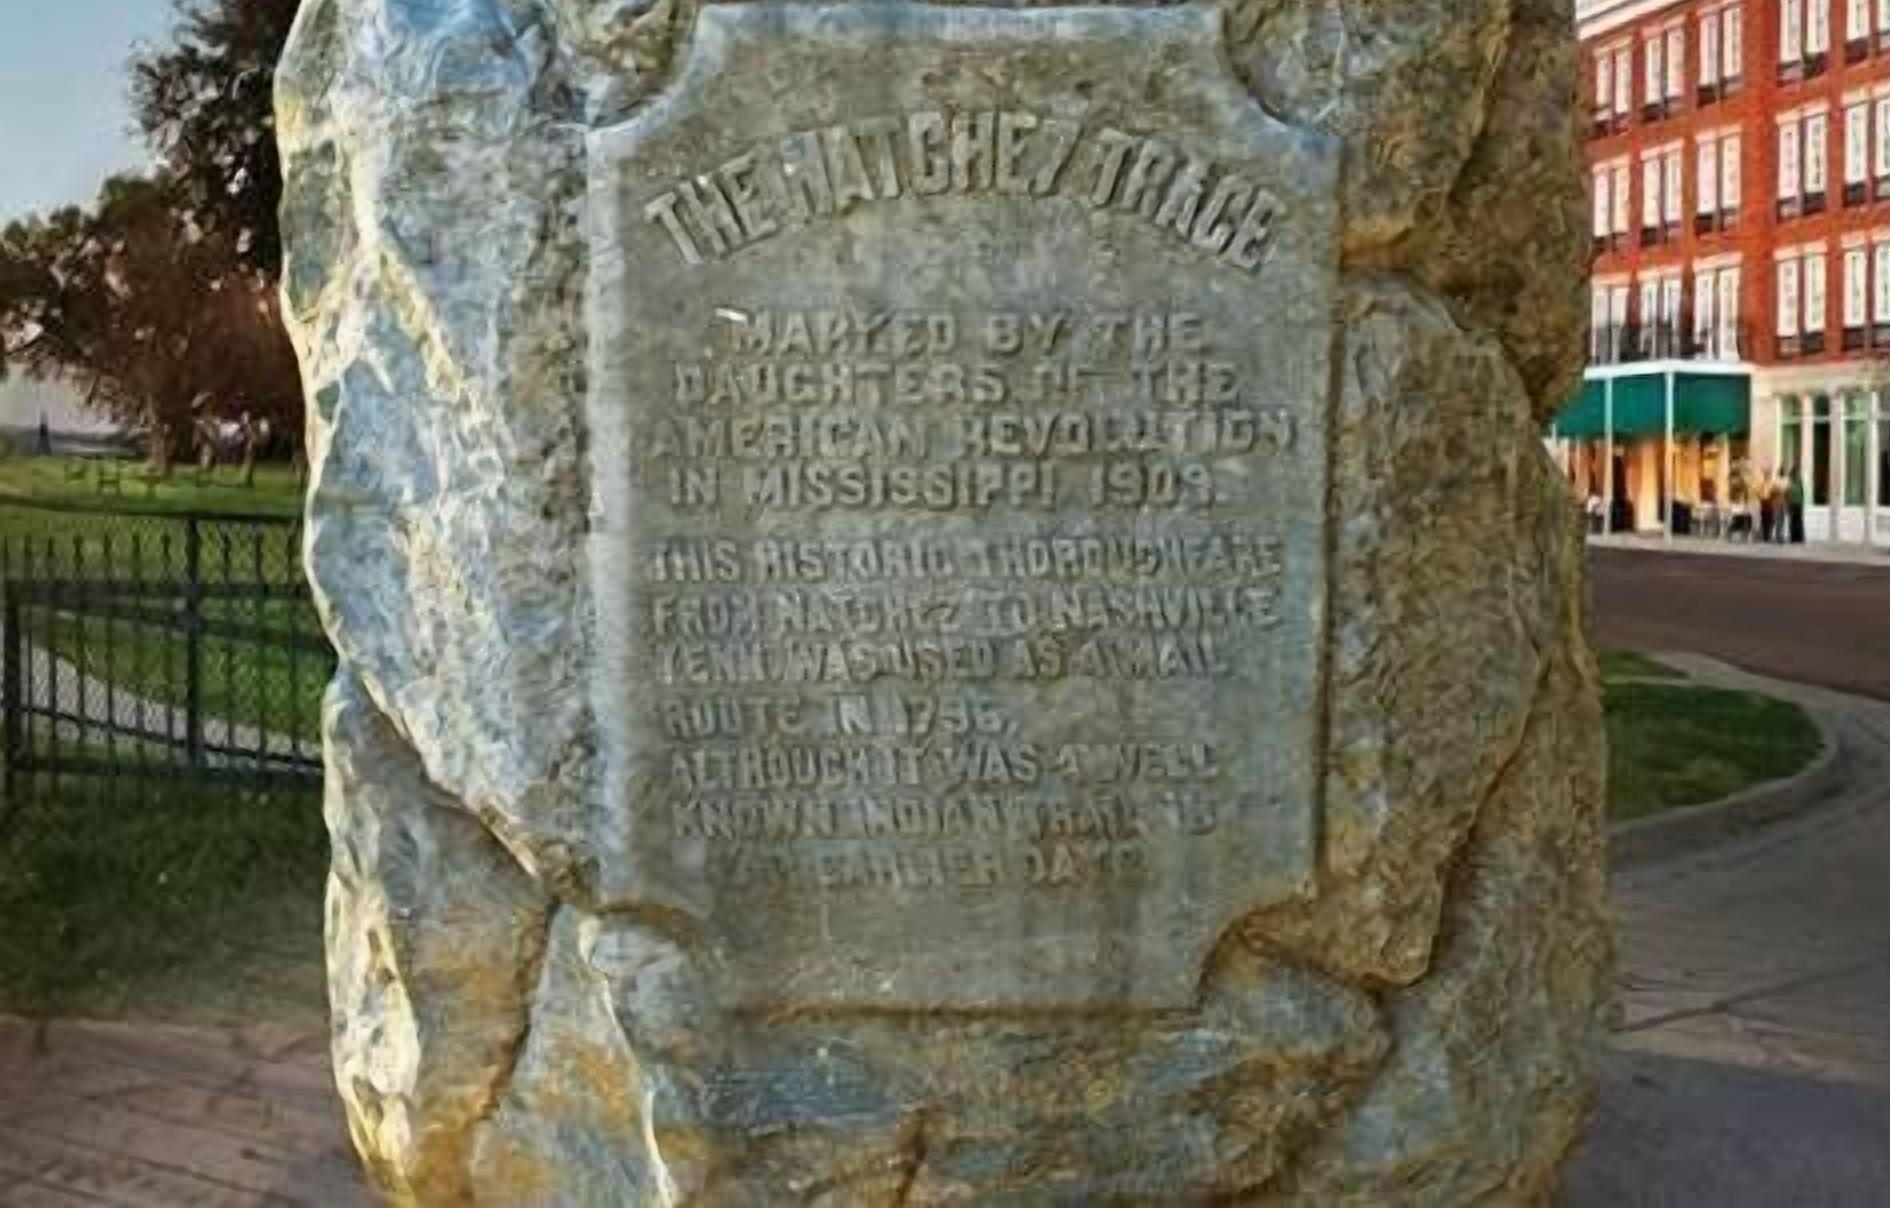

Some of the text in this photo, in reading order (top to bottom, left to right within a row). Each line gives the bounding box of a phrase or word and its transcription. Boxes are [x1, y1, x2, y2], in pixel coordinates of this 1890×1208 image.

[643, 148, 779, 265] THE
[985, 312, 1070, 356] BY
[1087, 311, 1206, 355] THE
[1130, 360, 1242, 407] THE
[669, 464, 721, 508] IN
[743, 461, 1057, 514] MISSISSIPPI
